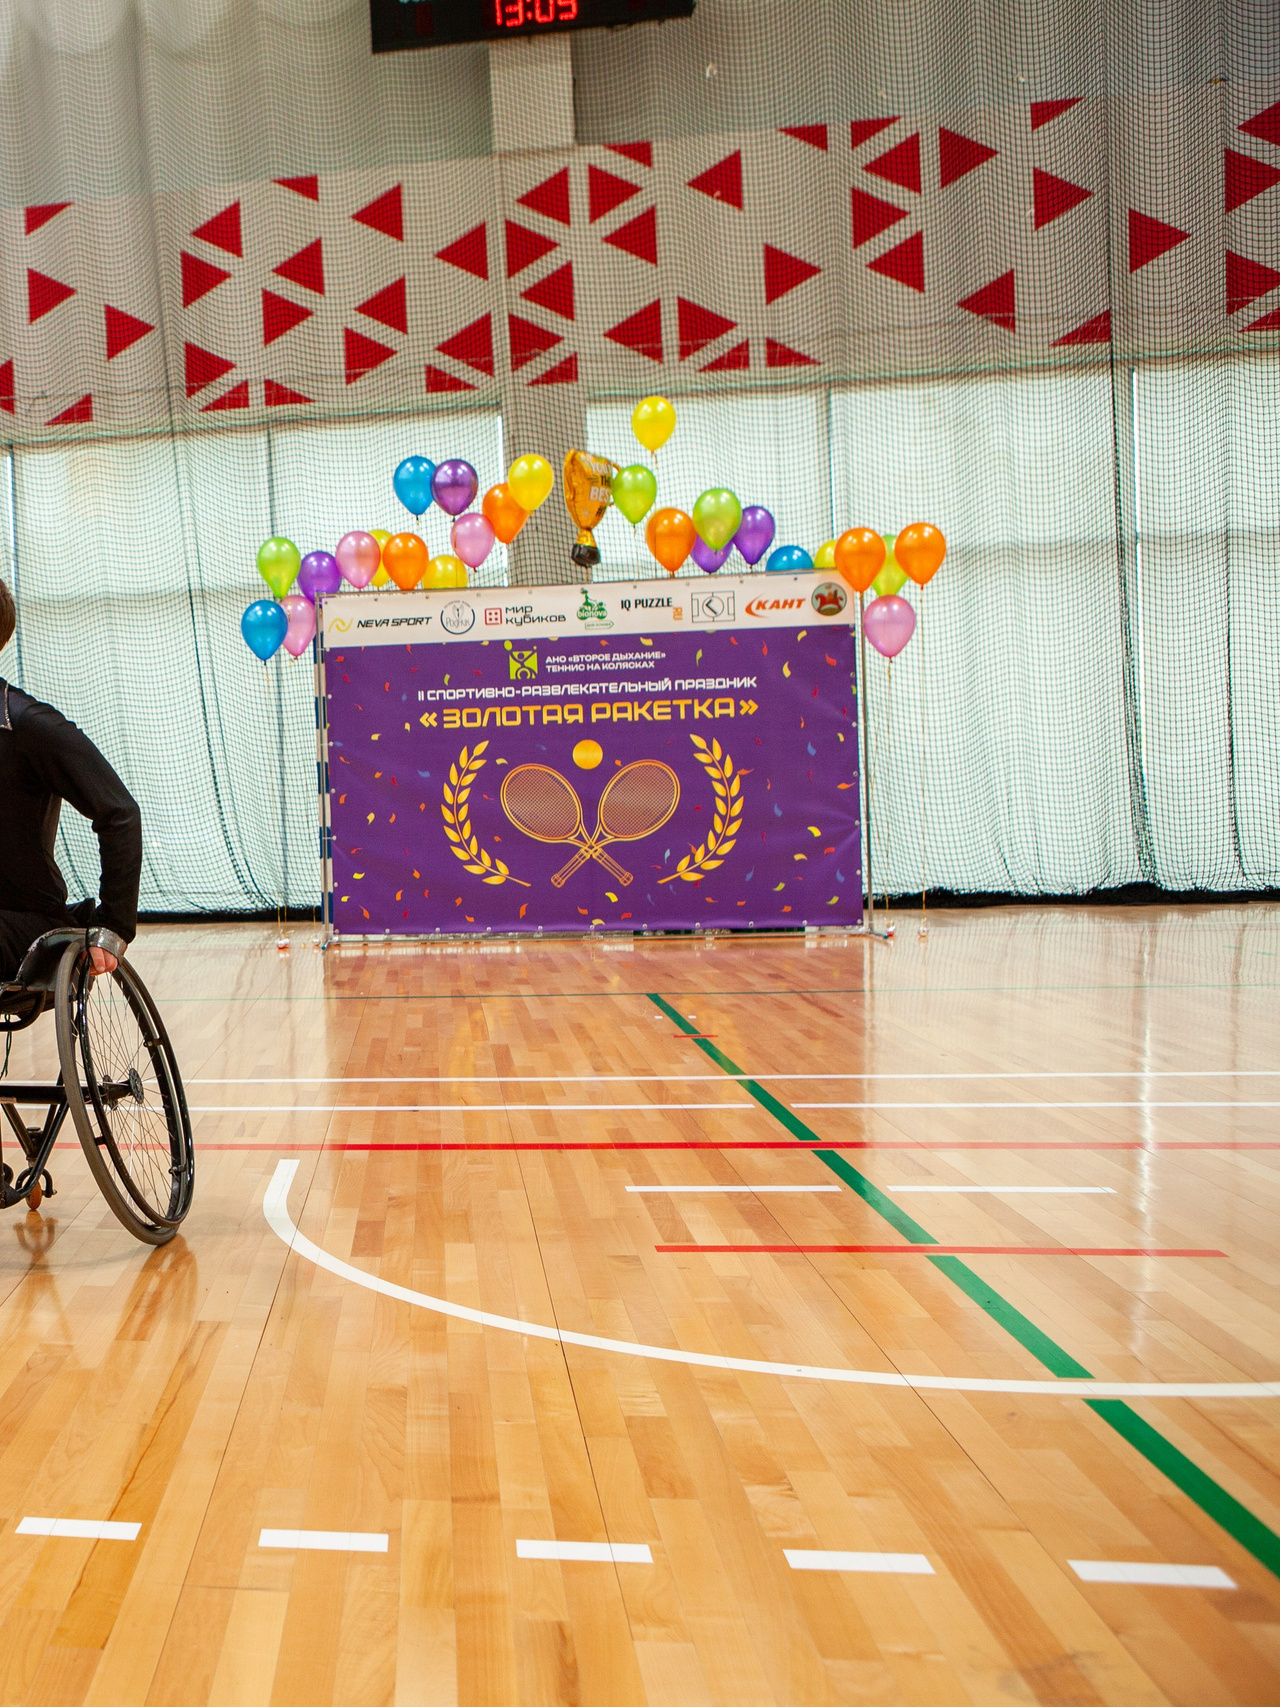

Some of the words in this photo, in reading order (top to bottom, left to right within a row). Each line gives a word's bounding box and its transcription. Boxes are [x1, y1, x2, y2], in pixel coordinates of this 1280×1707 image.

[495, 0, 579, 28] 13:05
[621, 599, 631, 611] IQ
[634, 597, 673, 609] PUZZLE
[755, 598, 806, 611] КАНТ
[357, 618, 390, 629] NEVA
[391, 616, 433, 627] SPORT
[545, 655, 567, 664] АНО
[568, 653, 611, 663] «ВТОРОЕ
[612, 651, 666, 662] ДЫХАНИЕ»
[545, 663, 586, 673] ТЕННИС
[586, 662, 601, 672] НА
[602, 660, 655, 671] КОЛЯСКАХ
[427, 677, 671, 701] СПОРТИВНО-РАЗВЛЕКАТЕЛЬНЫЙ
[674, 676, 758, 691] ПРАЗДНИК
